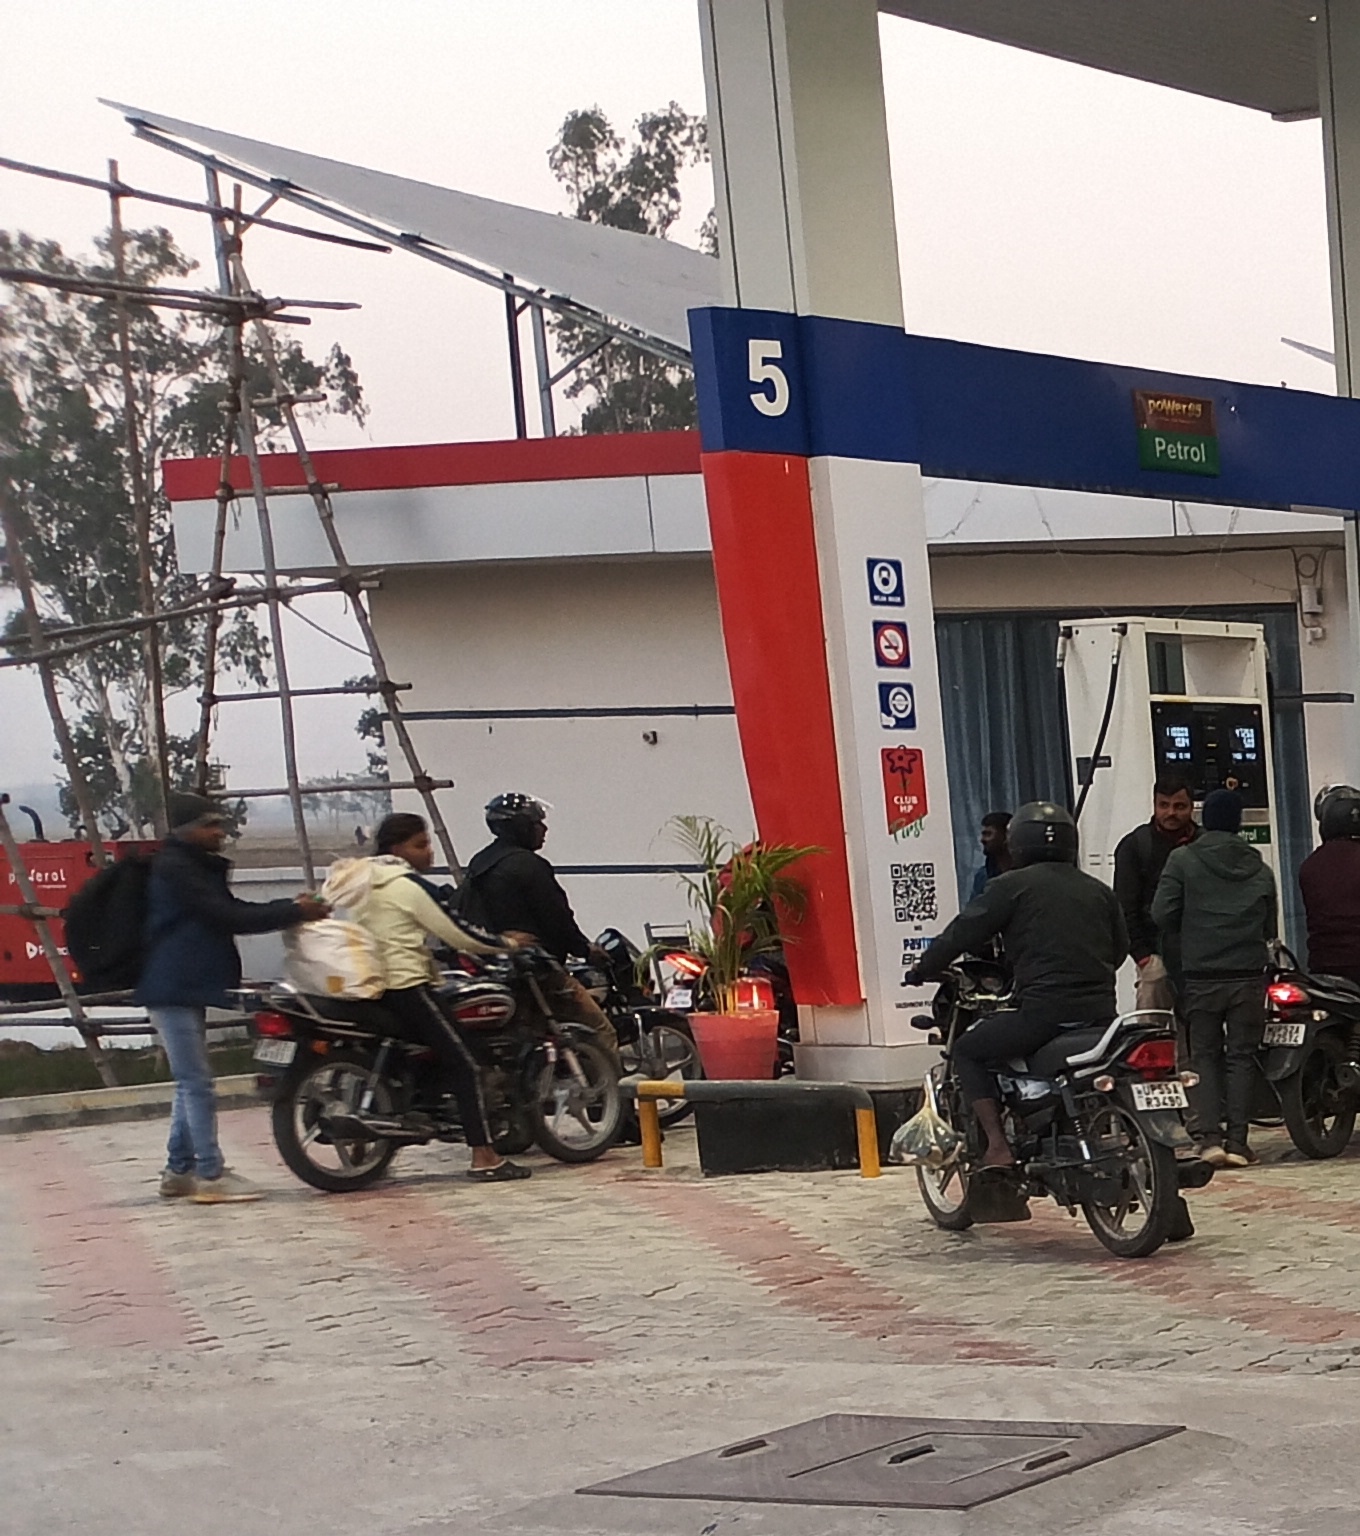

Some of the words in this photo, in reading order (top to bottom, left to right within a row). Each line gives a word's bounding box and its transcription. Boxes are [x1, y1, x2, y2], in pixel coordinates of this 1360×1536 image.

[748, 339, 789, 416] 5
[1154, 436, 1206, 463] Petrol
[893, 795, 918, 804] CLUB
[899, 805, 914, 813] HP
